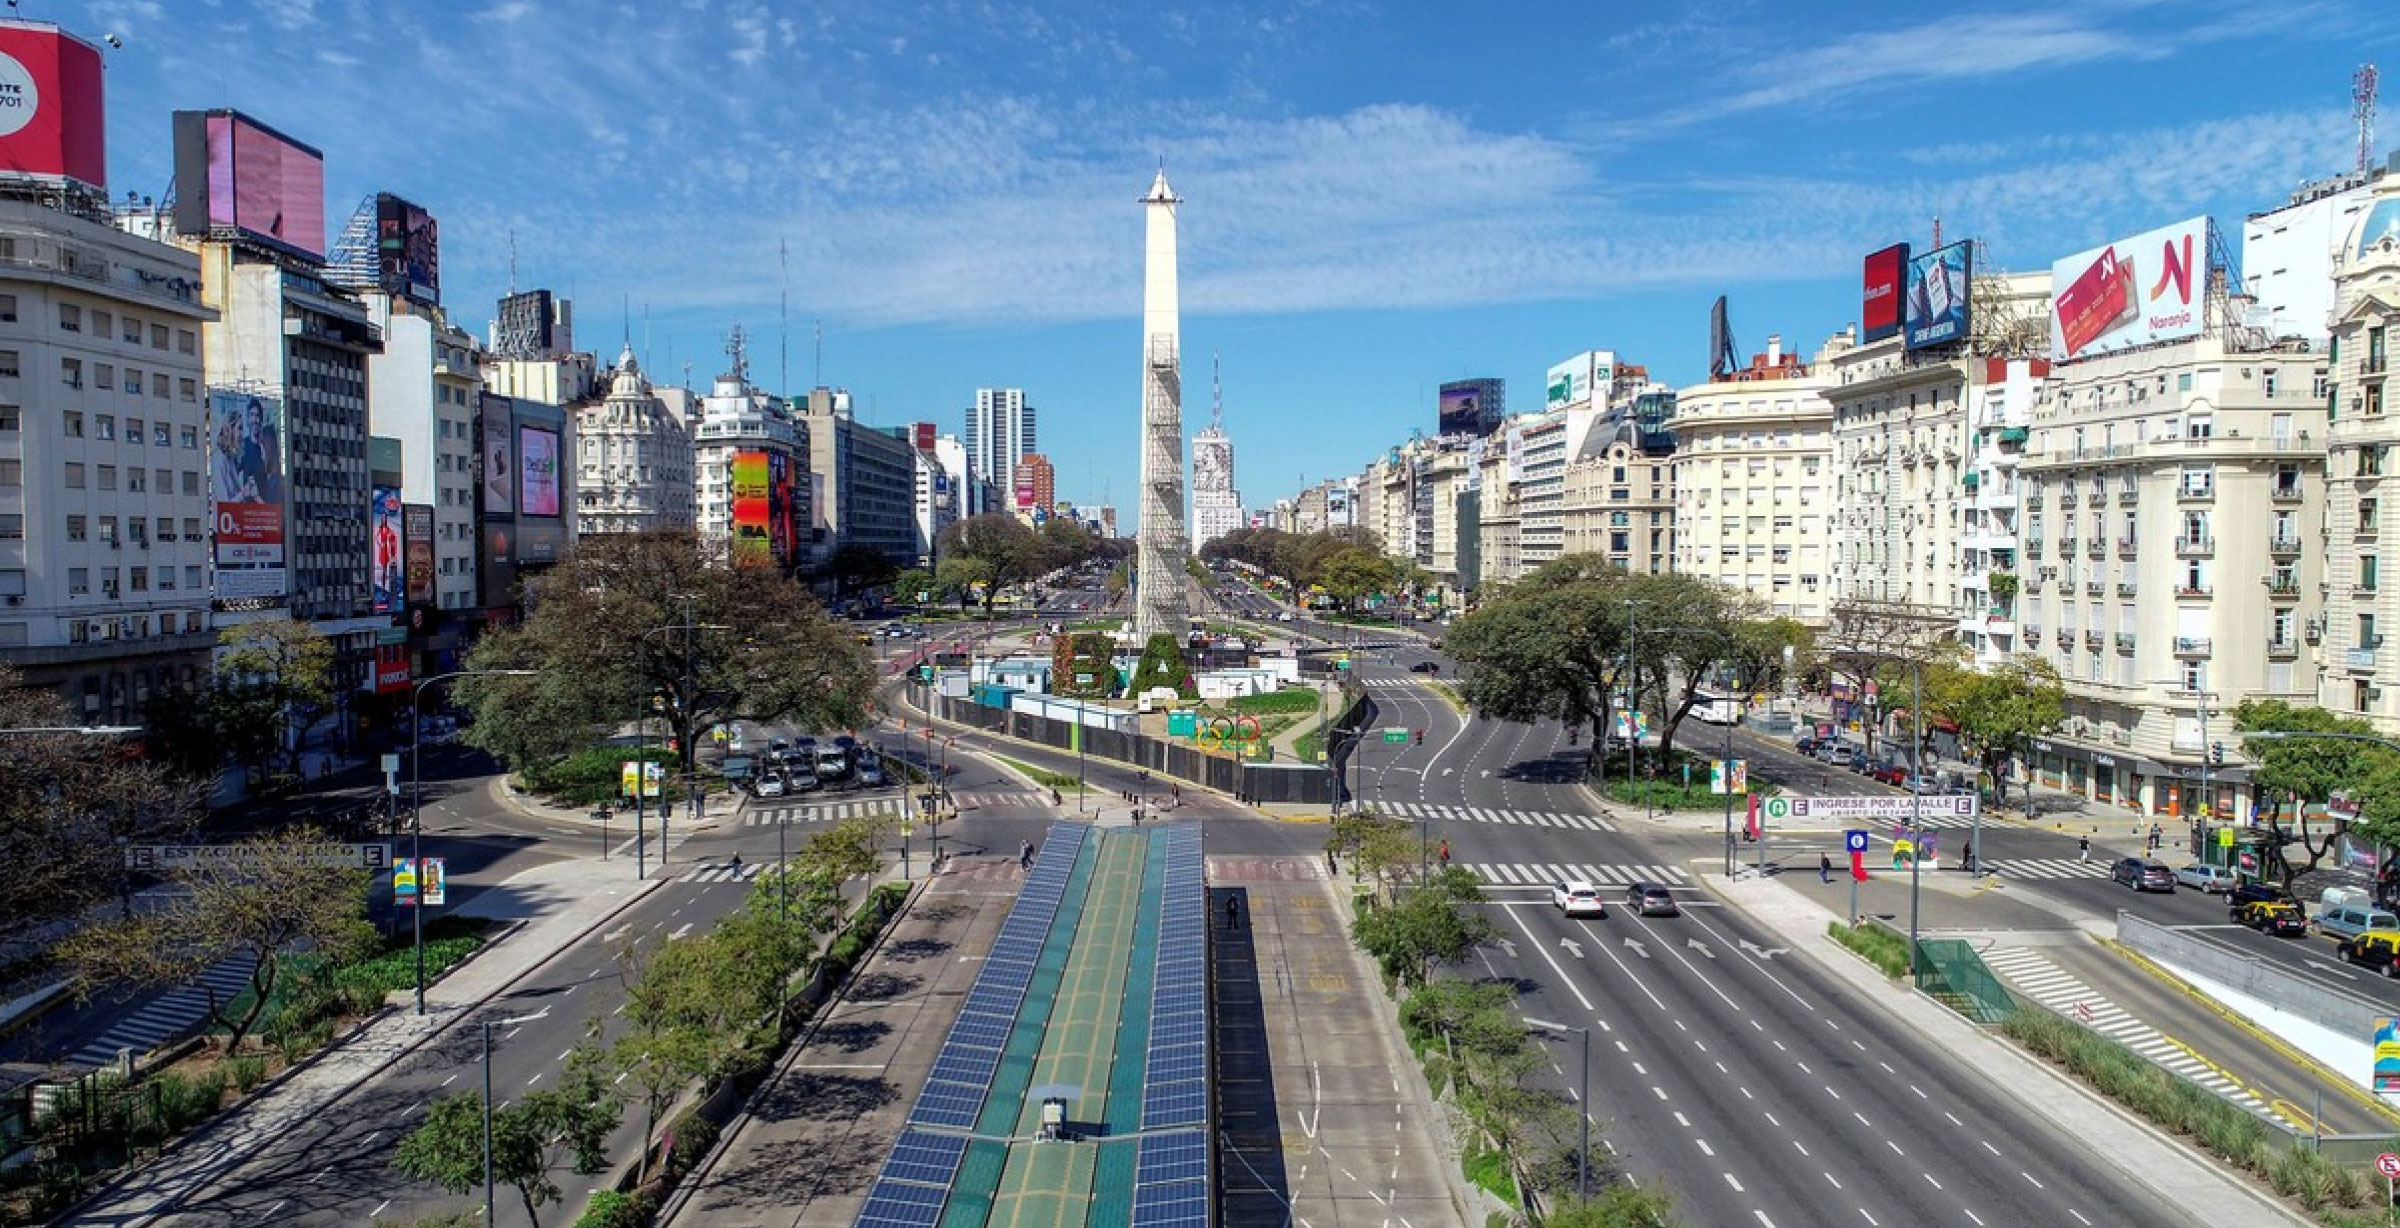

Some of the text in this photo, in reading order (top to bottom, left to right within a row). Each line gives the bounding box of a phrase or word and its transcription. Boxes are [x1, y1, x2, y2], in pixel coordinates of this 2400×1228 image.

[2148, 311, 2191, 331] Naranja
[1812, 799, 1866, 809] INGRESE
[1870, 799, 1896, 809] POR
